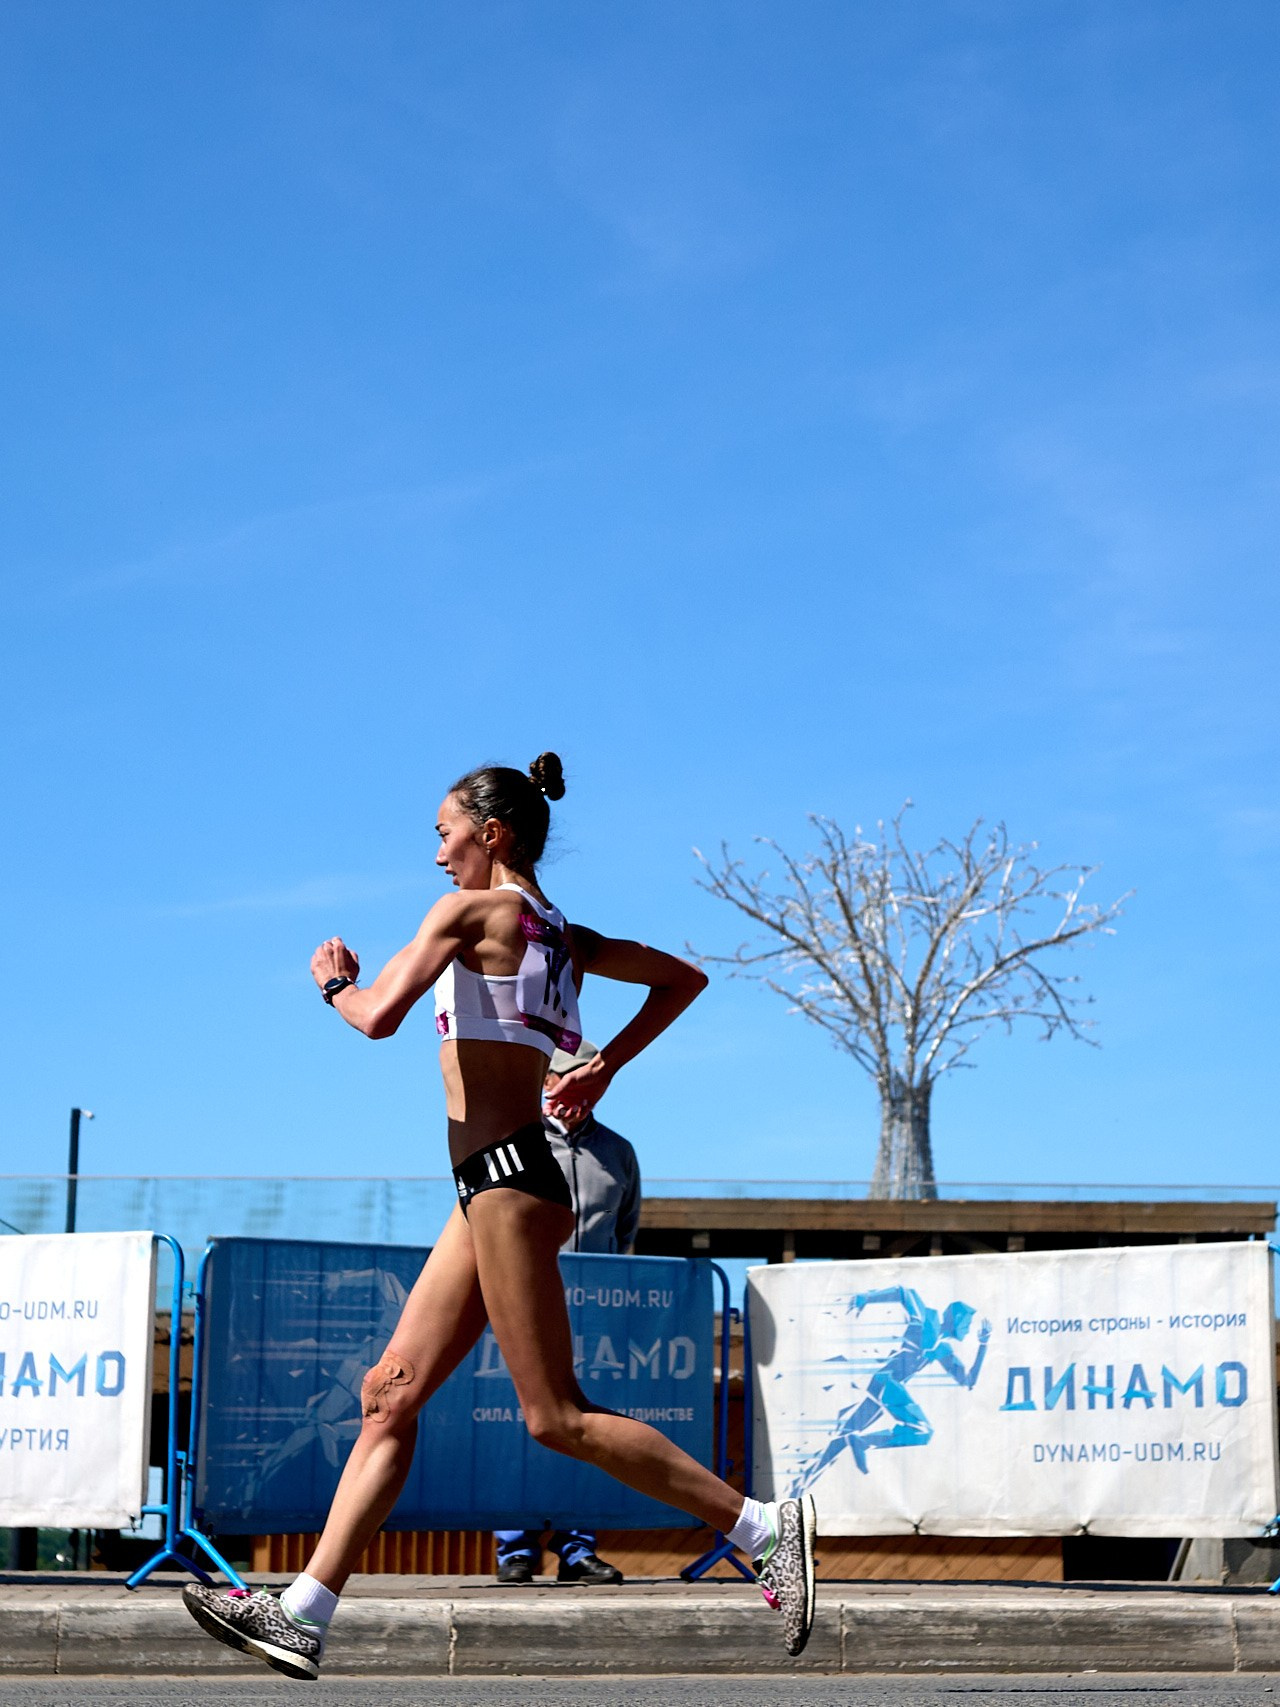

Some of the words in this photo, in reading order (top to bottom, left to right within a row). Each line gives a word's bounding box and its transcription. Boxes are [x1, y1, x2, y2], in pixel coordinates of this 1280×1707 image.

[1007, 1317, 1082, 1336] История
[1089, 1316, 1150, 1334] страны
[1169, 1312, 1247, 1331] история
[473, 1333, 696, 1380] ДАМО
[999, 1361, 1248, 1411] ДИНАМО
[472, 1407, 513, 1422] СИЛА
[1033, 1442, 1222, 1463] DYNAMO-UDM.RU
